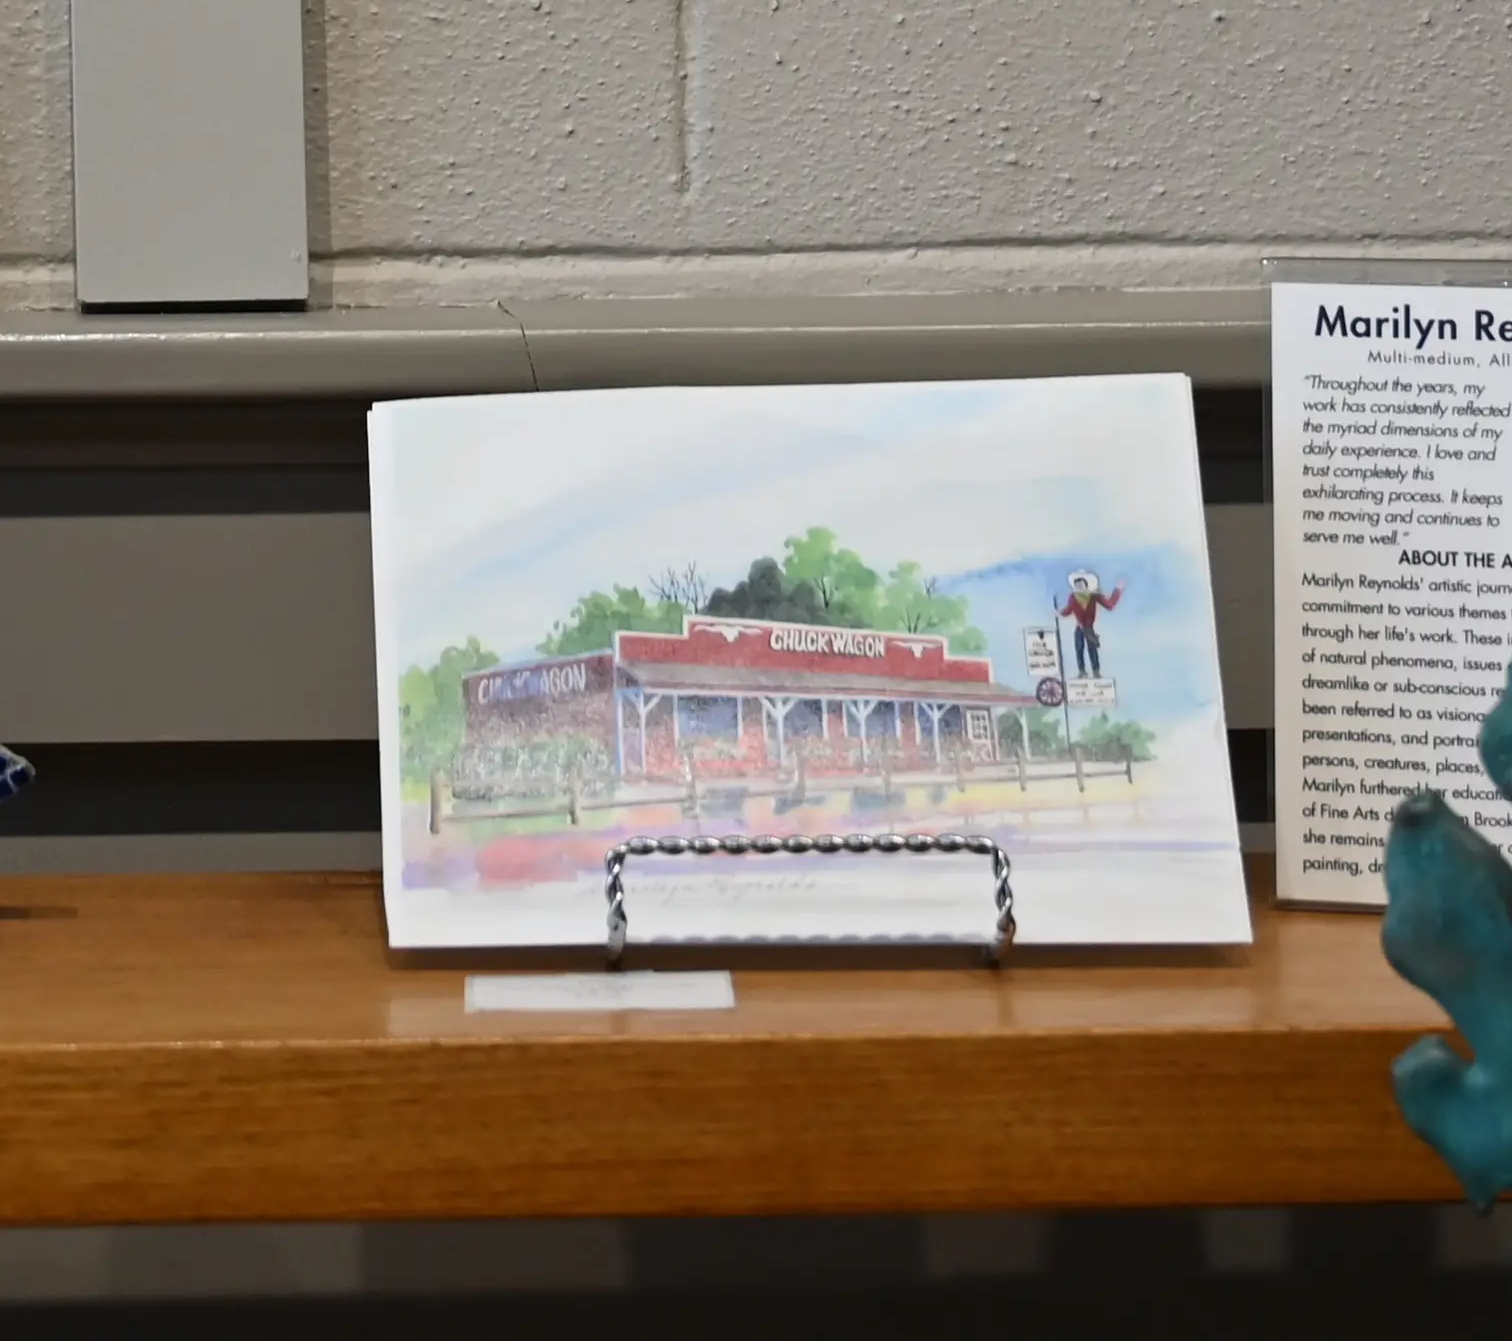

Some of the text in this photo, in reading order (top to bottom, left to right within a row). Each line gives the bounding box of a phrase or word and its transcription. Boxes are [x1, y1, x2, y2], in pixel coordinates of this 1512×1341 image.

[1314, 304, 1457, 349] Marilyn
[1367, 349, 1479, 368] Multi-medium,
[1391, 376, 1412, 392] the
[1416, 383, 1457, 397] years,
[1463, 384, 1485, 398] my
[1302, 396, 1511, 419] work has consistently reflected
[1302, 417, 1502, 443] the myriad dimensions of my
[1302, 438, 1497, 461] daily experience. I love and
[1302, 462, 1434, 484] trust completely this
[1302, 483, 1502, 508] exhilarating process. It keeps
[1398, 549, 1458, 566] ABOUT
[1463, 552, 1494, 568] THE
[769, 627, 887, 659] CHUCK WAGON
